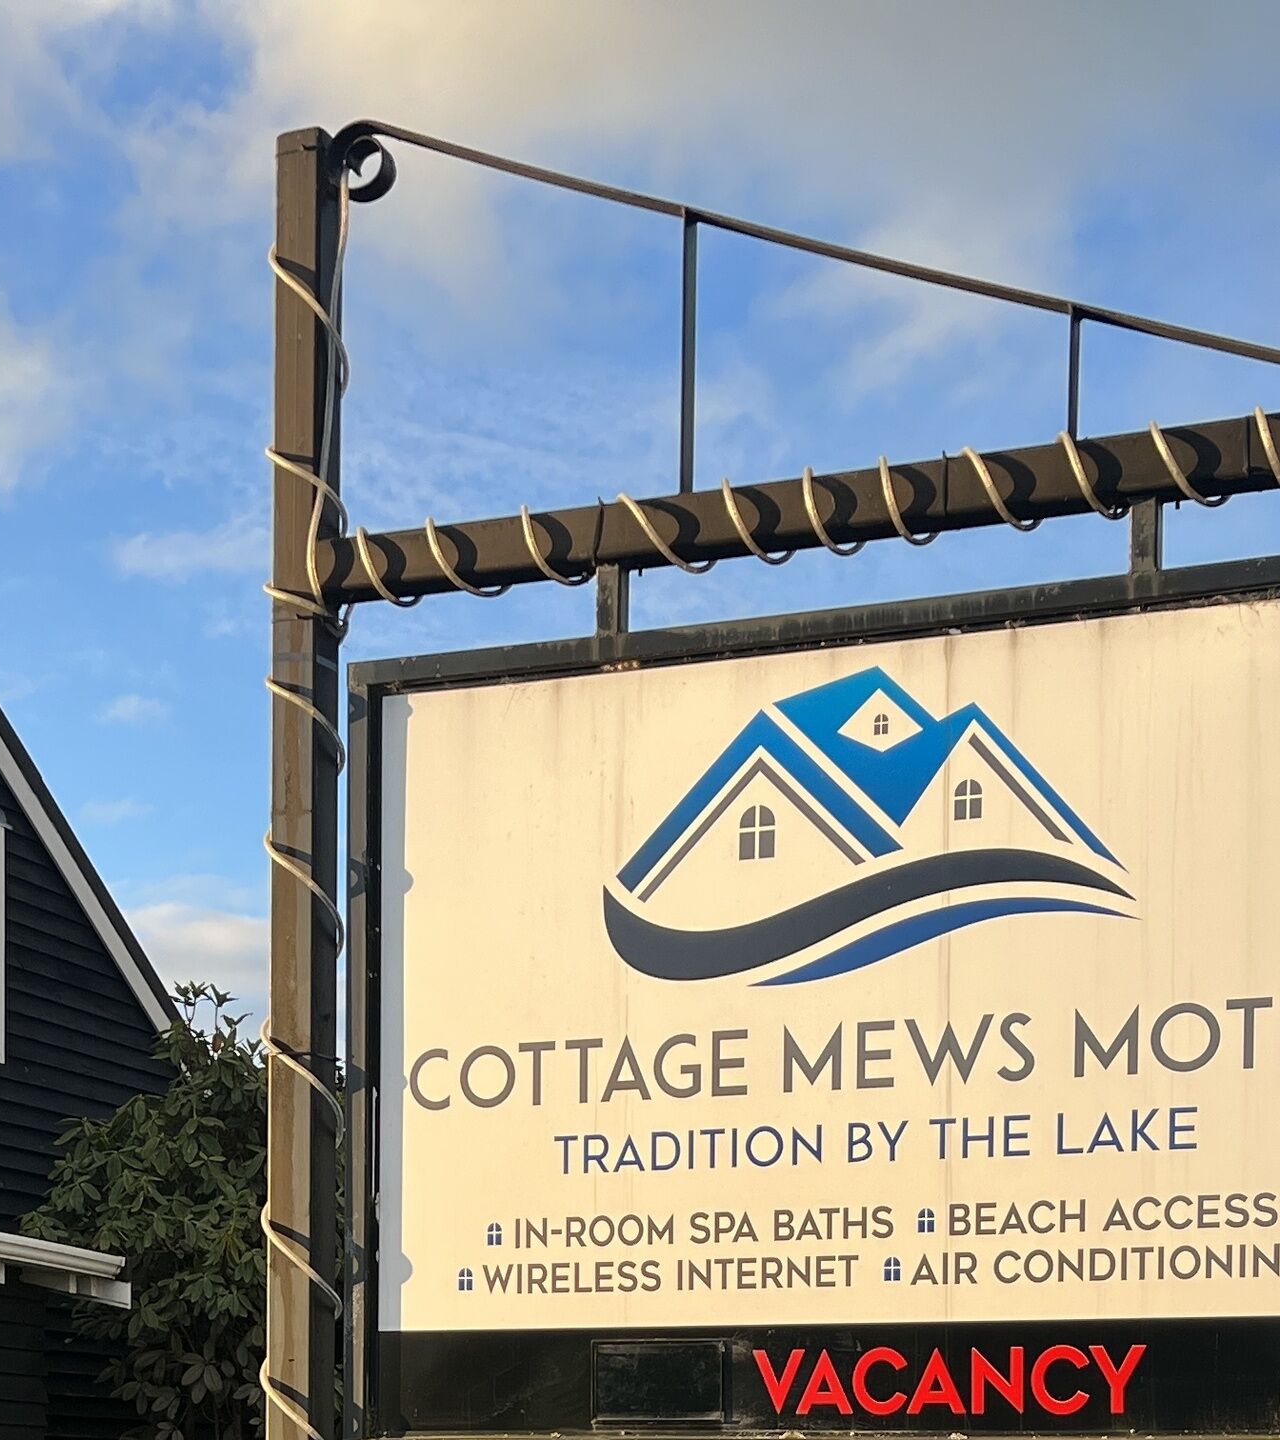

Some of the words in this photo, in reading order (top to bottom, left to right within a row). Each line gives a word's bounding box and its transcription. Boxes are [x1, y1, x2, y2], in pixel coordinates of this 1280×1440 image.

[409, 1028, 748, 1111] COTTAGE
[783, 1012, 1035, 1093] MEWS
[554, 1124, 823, 1175] TRADITION
[847, 1120, 909, 1163] BY
[928, 1114, 1031, 1160] THE
[1056, 1106, 1198, 1155] LAKE
[515, 1214, 674, 1249] IN-ROOM
[689, 1211, 759, 1245] SPA
[773, 1205, 894, 1242] BATHS
[949, 1198, 1086, 1236] BEACH
[1102, 1192, 1278, 1232] ACCESS
[482, 1260, 662, 1294] WIRELESS
[677, 1254, 859, 1291] INTERNET
[910, 1251, 978, 1286] AIR
[753, 1343, 1147, 1417] VACANCY
